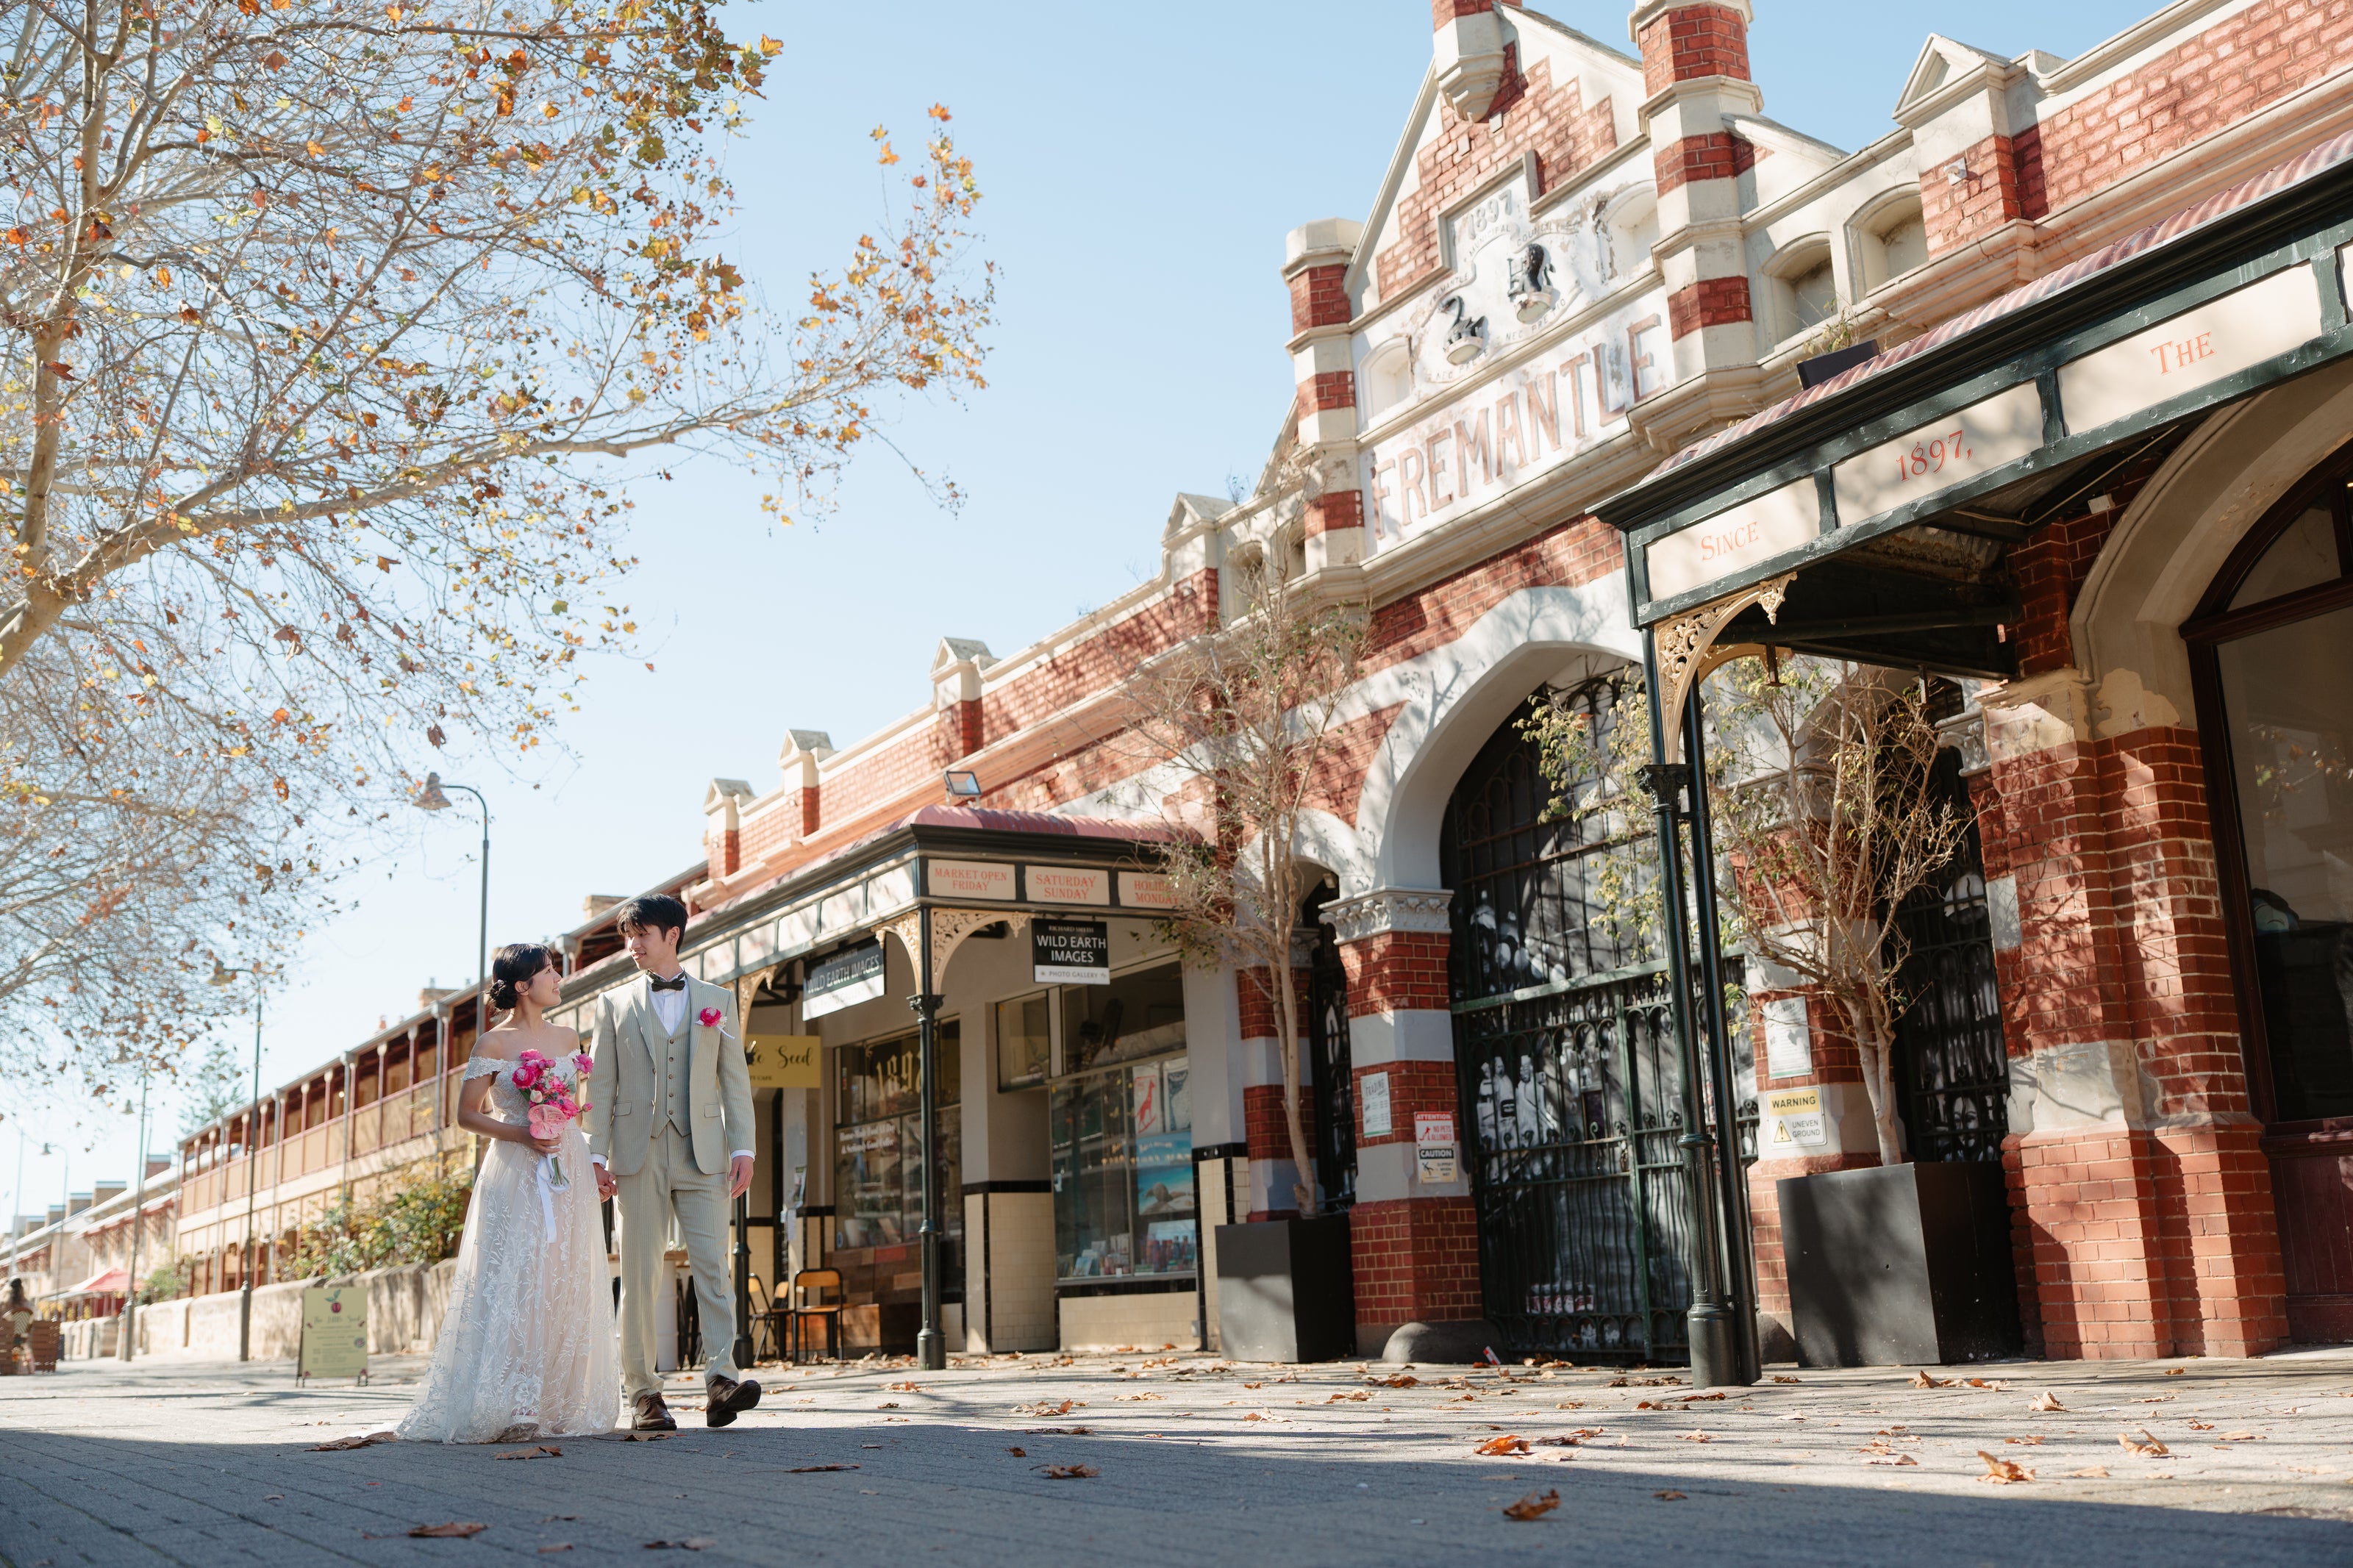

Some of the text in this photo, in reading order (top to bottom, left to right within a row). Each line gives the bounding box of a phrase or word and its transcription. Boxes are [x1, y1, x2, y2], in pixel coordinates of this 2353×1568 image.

[1468, 189, 1513, 240] 1897
[1506, 330, 1523, 341] NEC
[1370, 312, 1666, 540] FREMANTLE
[1700, 331, 2217, 562] SINCE 1897, THE
[935, 867, 1007, 881] MARKET OPEN
[1035, 874, 1096, 887] SATURDAY
[952, 880, 989, 891] FRIDAY
[1134, 880, 1171, 892] HOLIDA
[1044, 887, 1089, 900] SUNDAY
[1036, 935, 1107, 949] WILD EARTH
[1051, 950, 1094, 963] IMAGES
[807, 954, 879, 994] WILD EARTH IMAGES
[776, 1045, 813, 1069] Seed
[1772, 1096, 1816, 1109] WARNING
[1792, 1119, 1818, 1128] UNEVEN
[1792, 1129, 1821, 1138] GROUND
[1421, 1150, 1452, 1158] CAUTION
